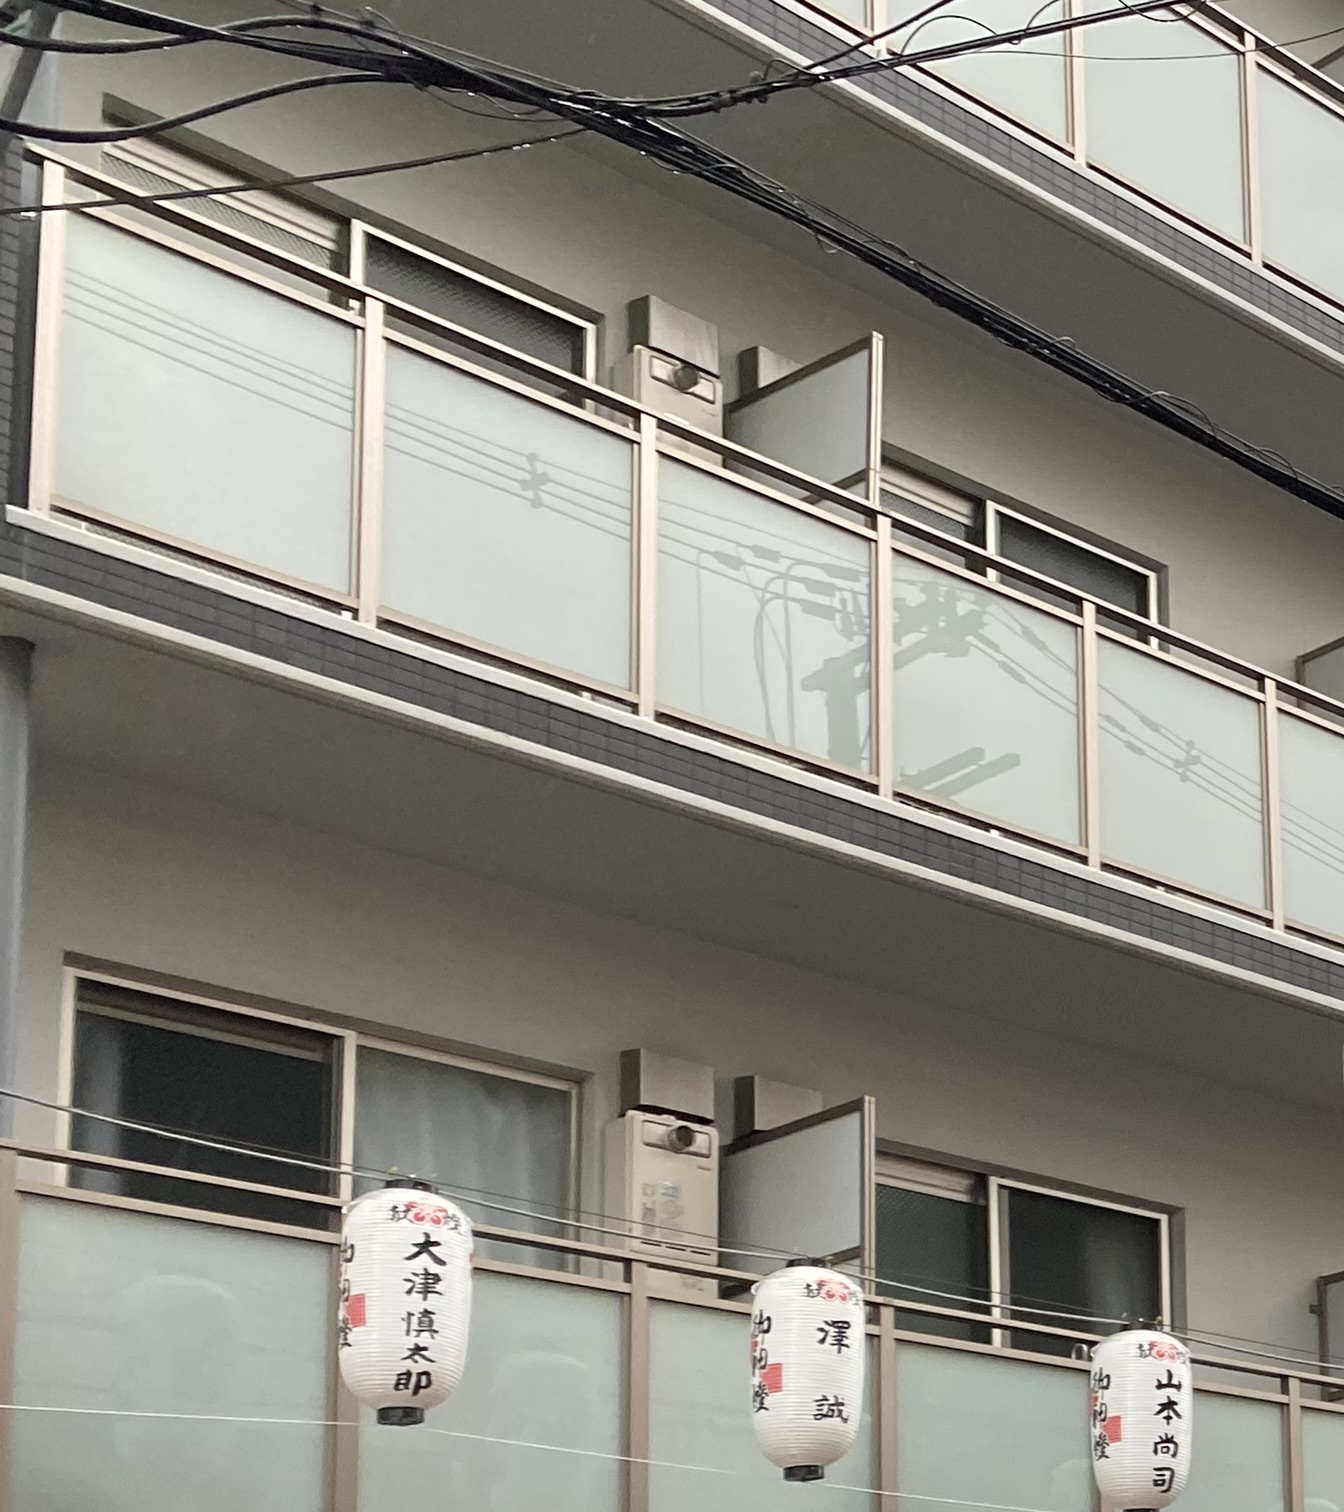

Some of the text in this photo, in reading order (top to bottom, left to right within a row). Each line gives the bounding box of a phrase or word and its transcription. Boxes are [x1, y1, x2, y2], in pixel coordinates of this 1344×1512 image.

[393, 1231, 448, 1397] 大津慎太郎
[1152, 1368, 1182, 1494] 山本尚司
